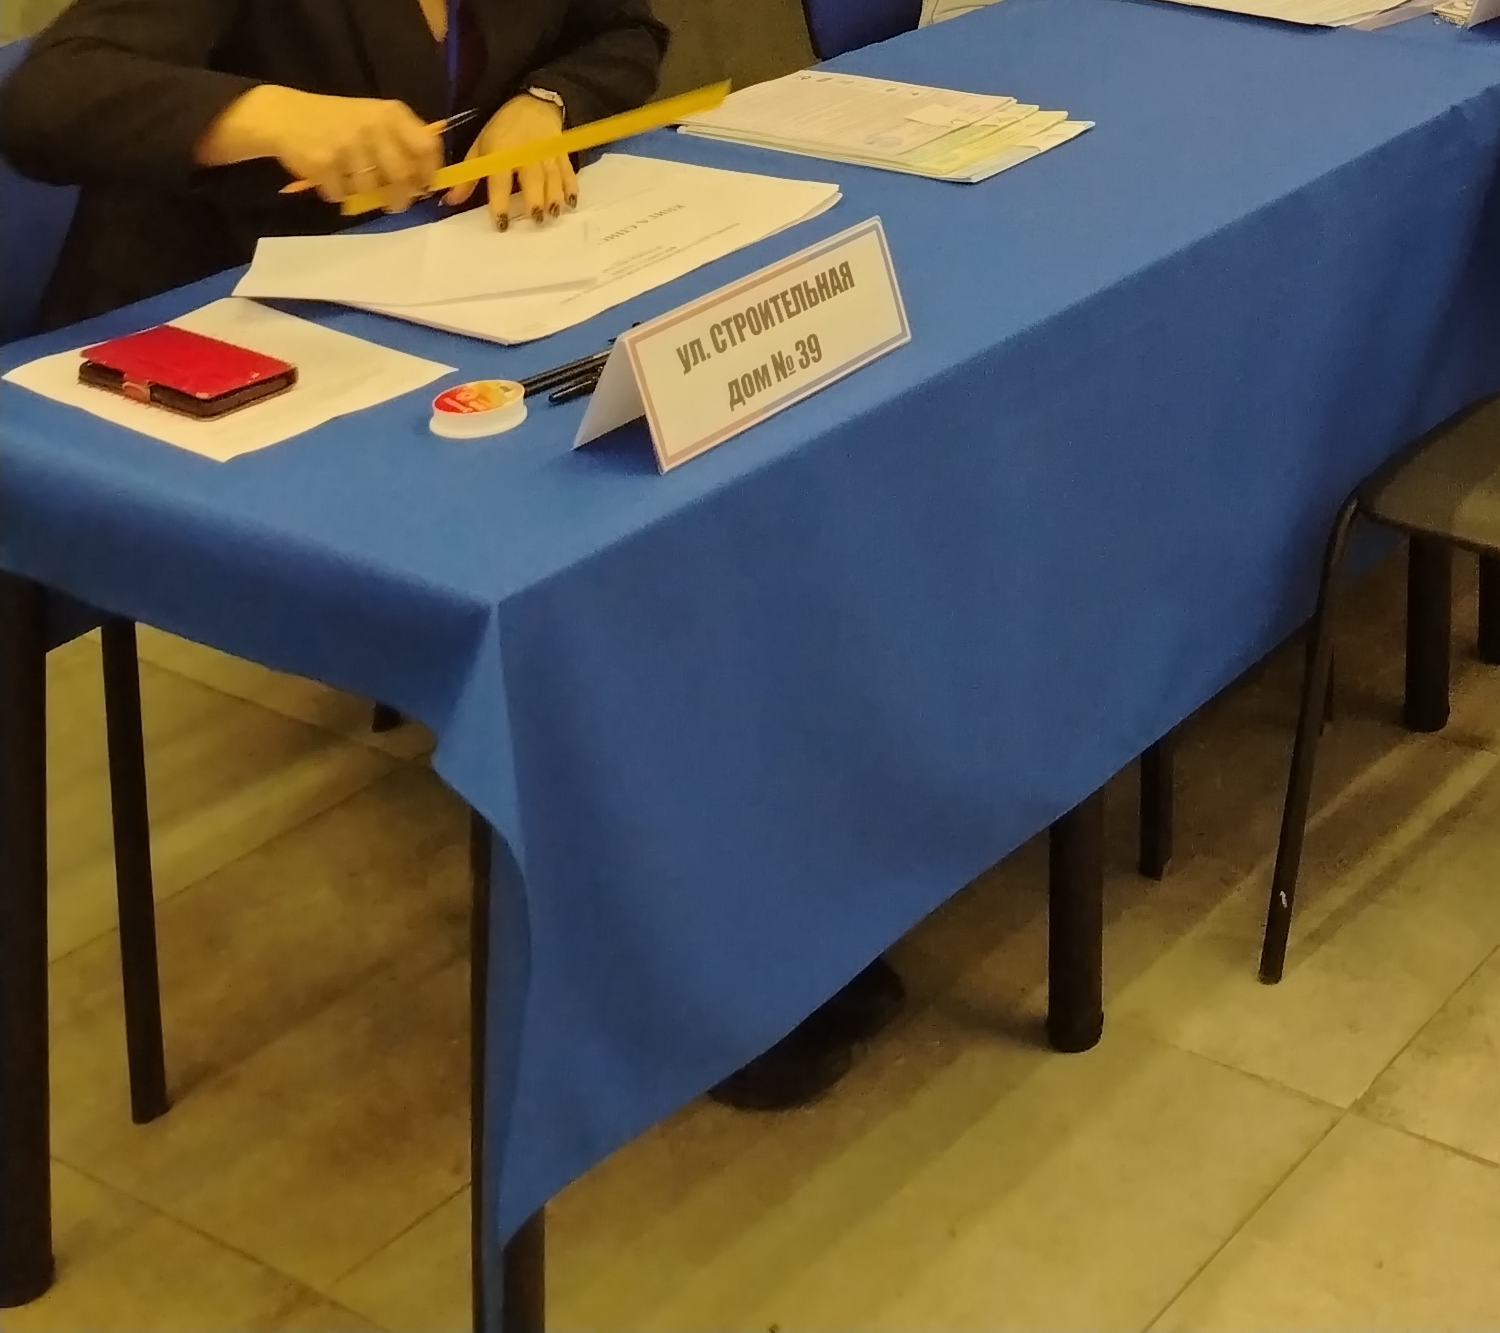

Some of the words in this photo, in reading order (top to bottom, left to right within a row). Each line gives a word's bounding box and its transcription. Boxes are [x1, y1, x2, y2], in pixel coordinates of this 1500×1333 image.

[676, 338, 712, 375] УЛ.
[709, 261, 856, 354] СТРОИТЕЛЬНАЯ
[727, 364, 773, 412] ДОМ
[770, 350, 797, 382] №
[795, 334, 823, 370] 39
